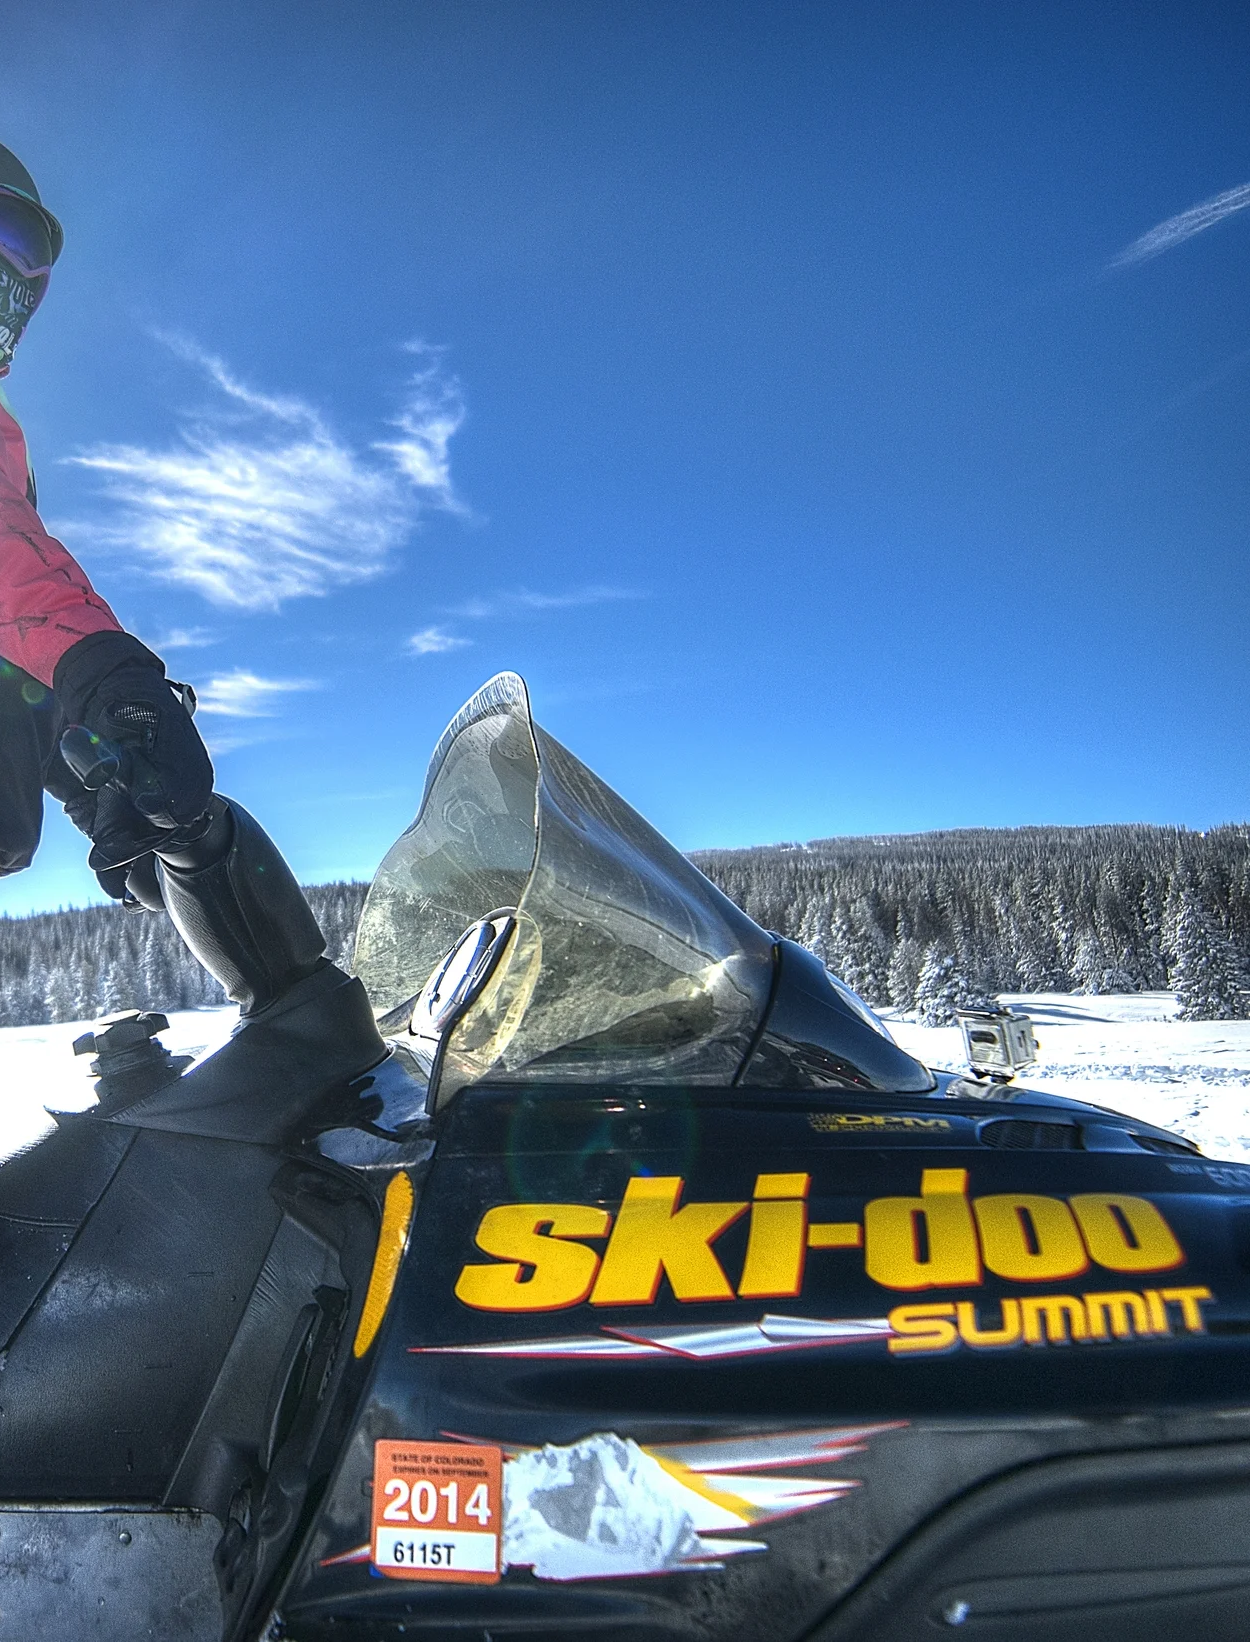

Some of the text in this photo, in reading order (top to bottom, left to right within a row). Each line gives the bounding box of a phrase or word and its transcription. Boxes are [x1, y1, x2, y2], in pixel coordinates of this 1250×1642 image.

[454, 1168, 1185, 1312] ski-doo
[887, 1285, 1211, 1356] SUMMIT
[391, 1453, 485, 1467] STATE OF COLORADO
[383, 1478, 492, 1526] 2014
[393, 1541, 455, 1566] 6115T
